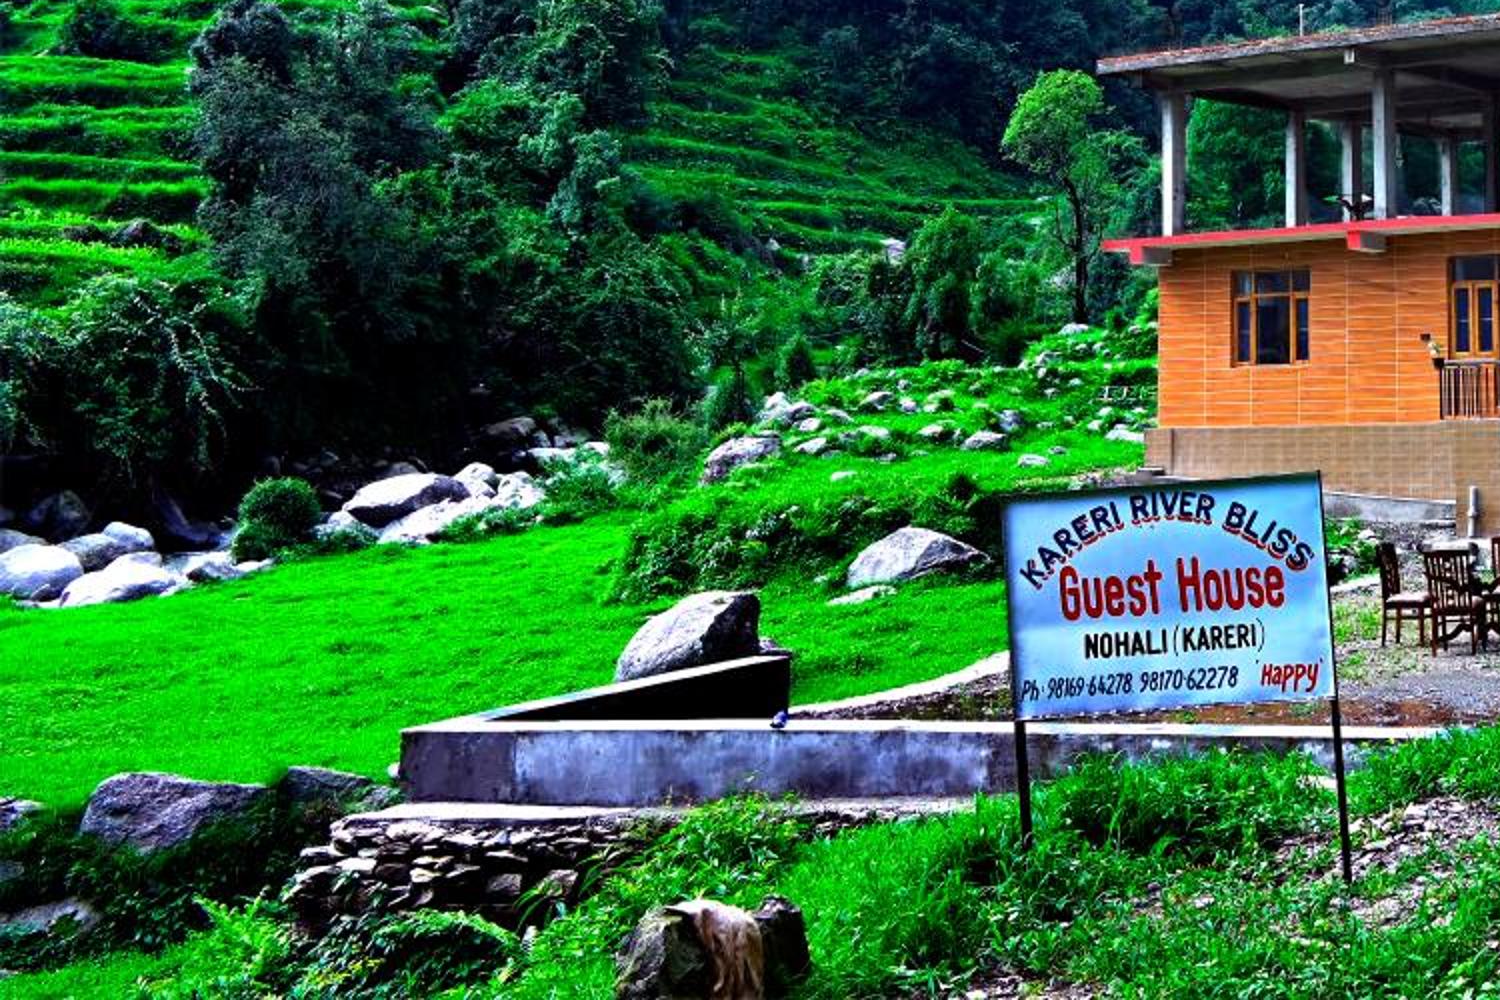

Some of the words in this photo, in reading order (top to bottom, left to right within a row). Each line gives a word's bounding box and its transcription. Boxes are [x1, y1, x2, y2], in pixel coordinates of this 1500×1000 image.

[1019, 501, 1125, 590] KARERI
[1129, 491, 1216, 525] RIVER
[1222, 501, 1315, 571] BLISS
[1058, 559, 1163, 622] Guest
[1176, 556, 1286, 613] House
[1084, 629, 1168, 660] NOHALI
[1173, 617, 1265, 656] (KARERI)
